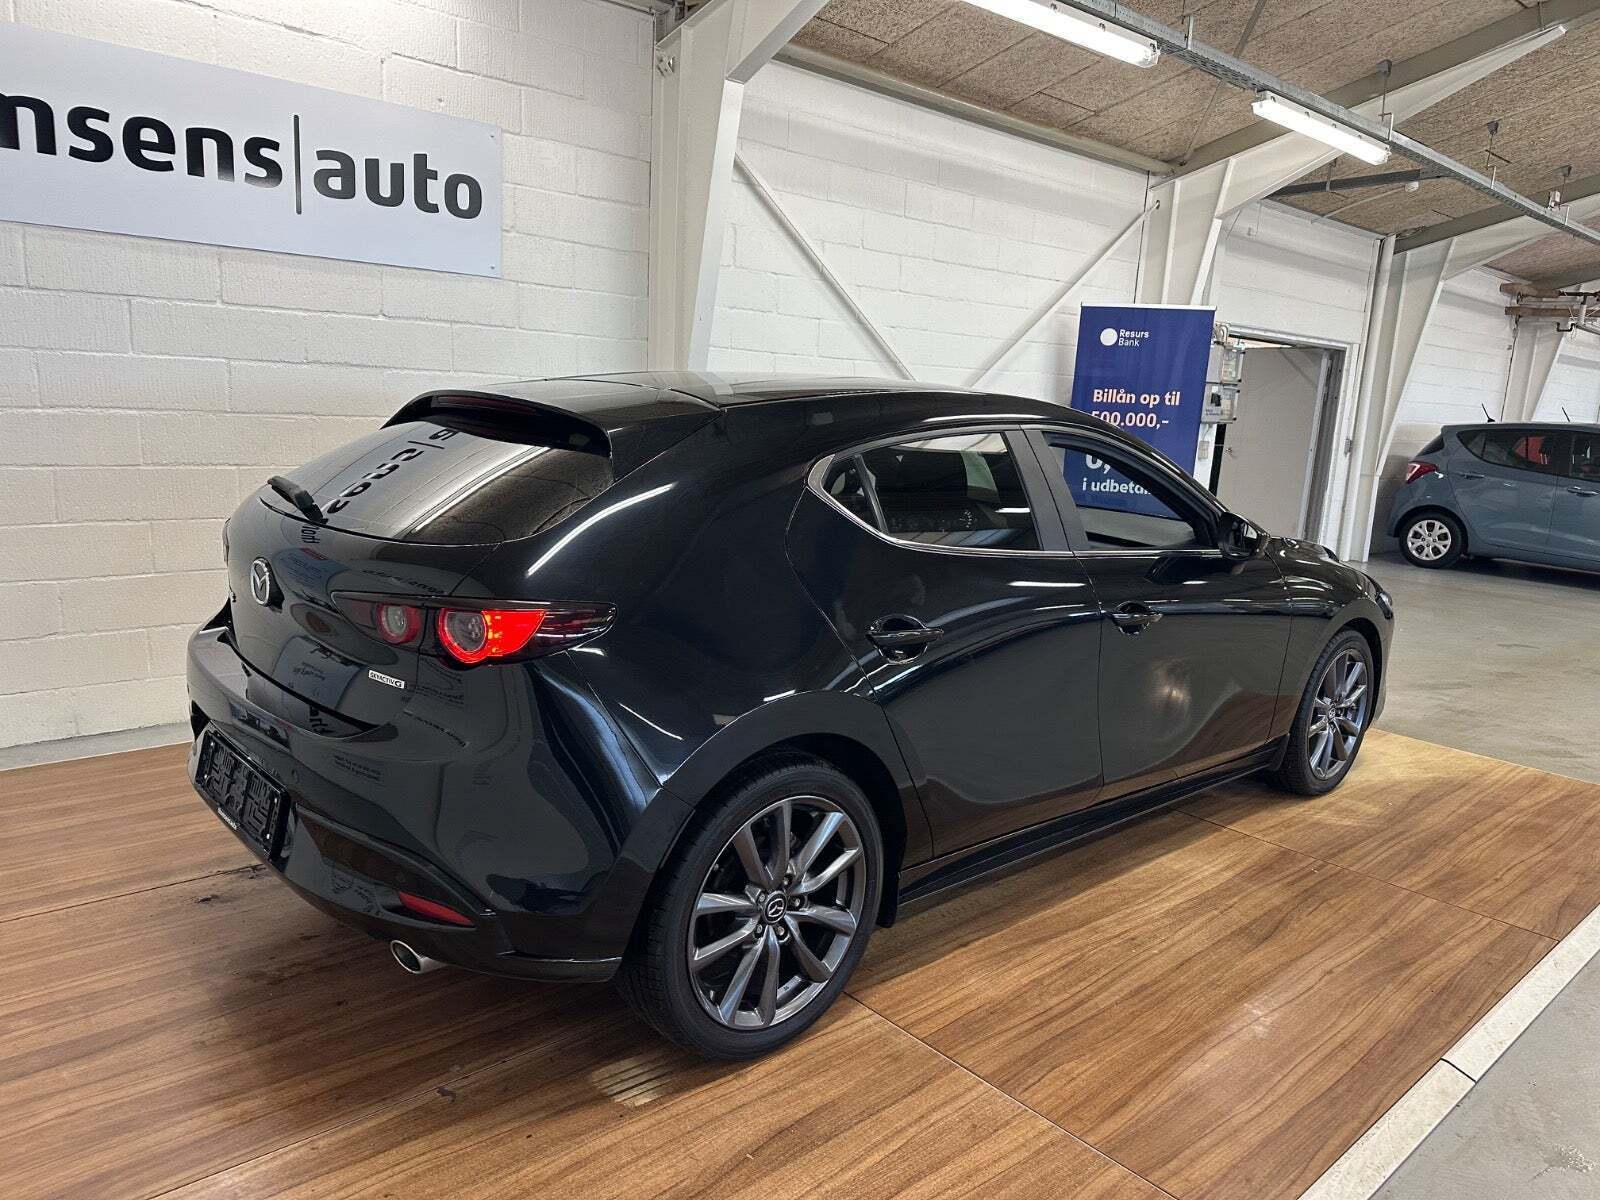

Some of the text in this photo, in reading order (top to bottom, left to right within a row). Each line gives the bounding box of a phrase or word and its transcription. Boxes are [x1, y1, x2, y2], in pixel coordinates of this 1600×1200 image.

[313, 149, 483, 220] auto
[1119, 328, 1149, 338] Resurs
[1118, 337, 1140, 347] Bank
[1093, 388, 1181, 408] Billån op til
[1082, 477, 1088, 491] i
